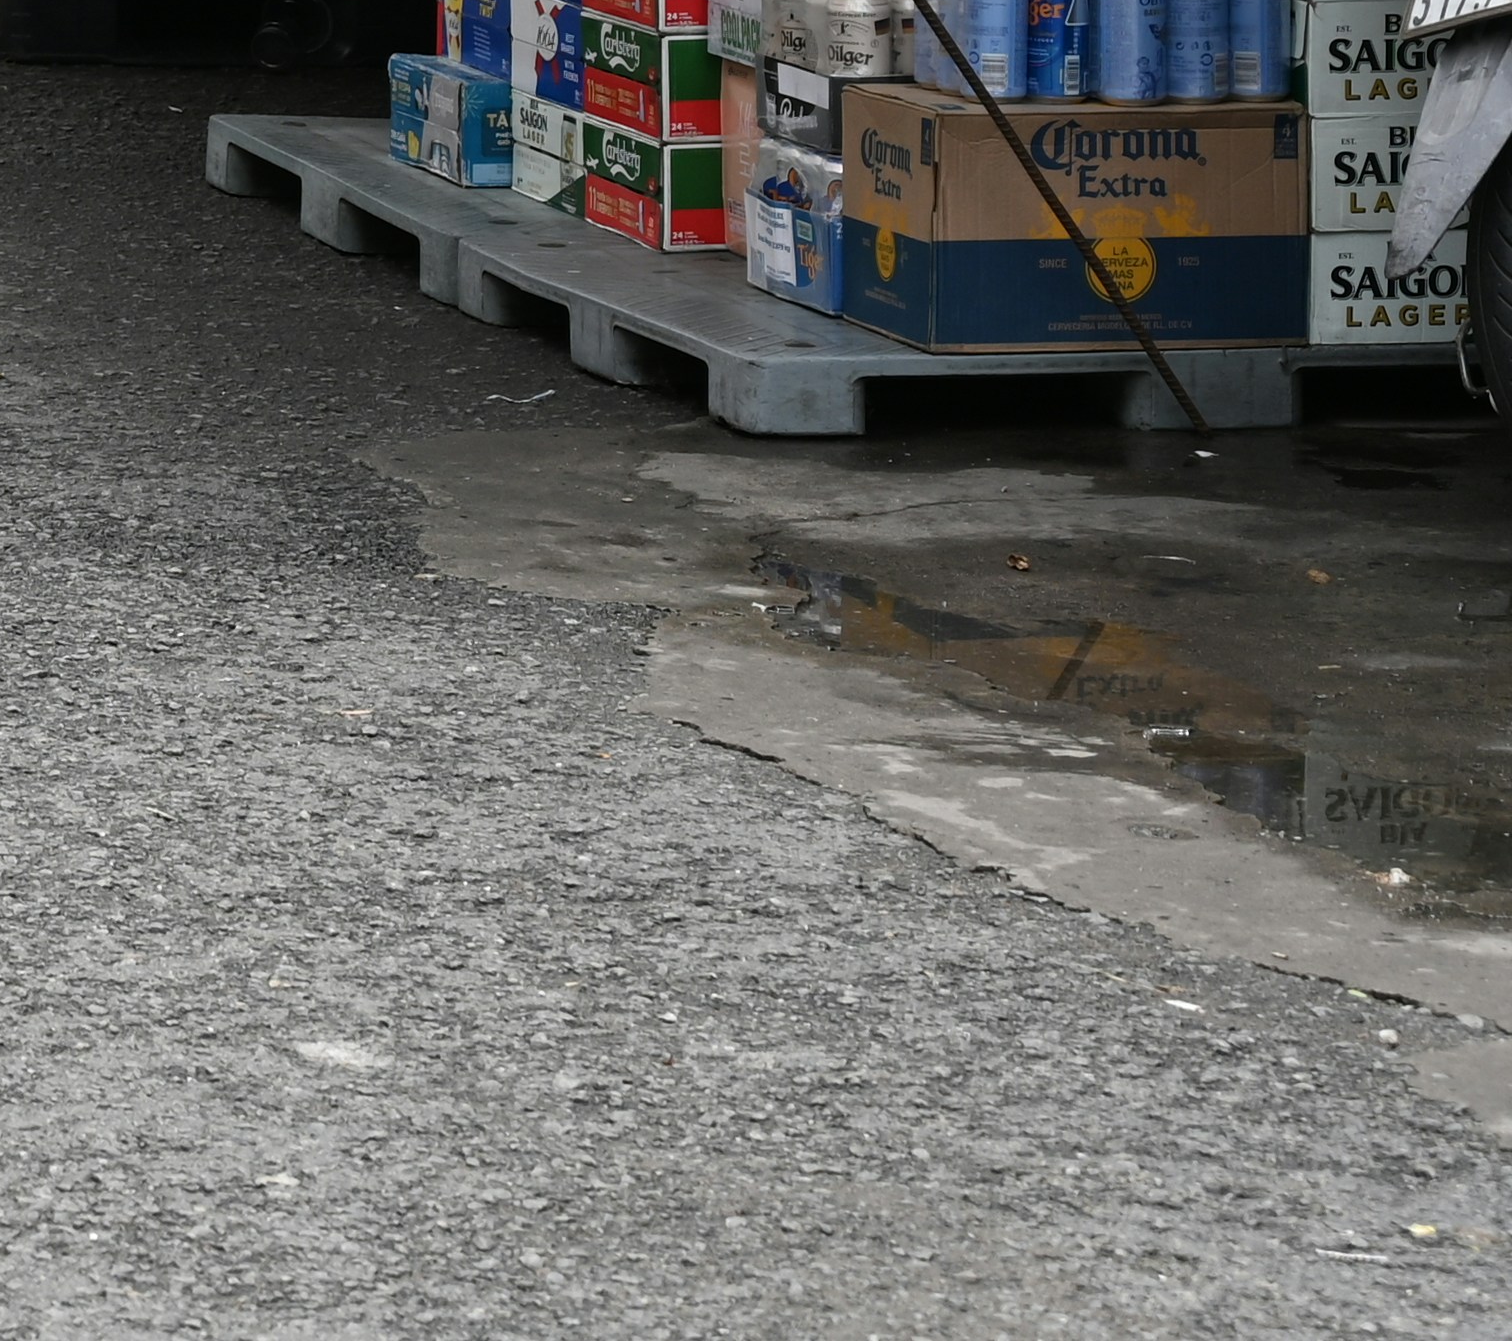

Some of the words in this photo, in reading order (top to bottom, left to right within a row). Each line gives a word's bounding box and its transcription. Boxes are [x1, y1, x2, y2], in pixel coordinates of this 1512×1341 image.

[666, 13, 677, 21] 24
[537, 25, 556, 50] 1664
[600, 22, 641, 63] Carlsberg
[1328, 38, 1451, 74] SAIGO
[1344, 77, 1419, 101] LAG
[519, 106, 549, 134] SAIGON
[670, 122, 683, 131] 24
[522, 127, 546, 145] LAGER
[1030, 118, 1201, 177] Corona
[602, 130, 641, 170] Carlsberg
[861, 127, 914, 179] Corona
[871, 168, 902, 201] Extra
[1077, 164, 1168, 199] Extra
[671, 231, 684, 239] 24
[1038, 257, 1068, 269] SINCE
[1099, 257, 1149, 269] ERVEZA
[1112, 247, 1130, 257] LA
[1177, 256, 1200, 268] 1925
[1330, 264, 1468, 300] SAIGO
